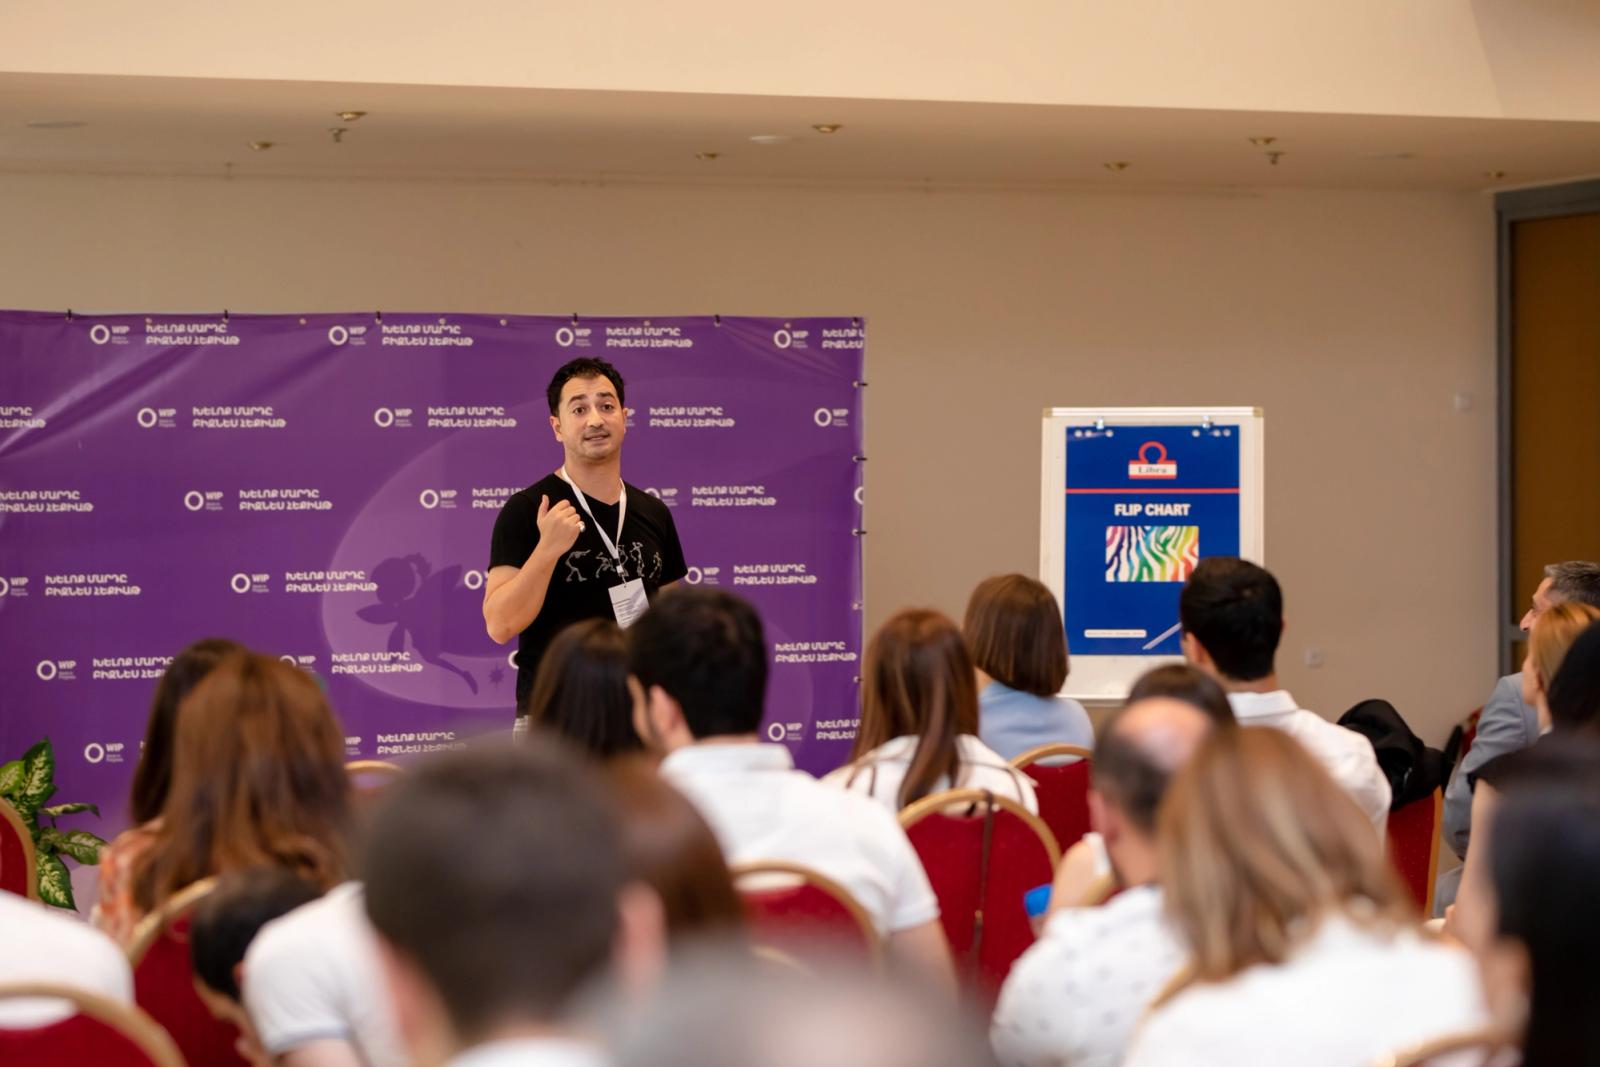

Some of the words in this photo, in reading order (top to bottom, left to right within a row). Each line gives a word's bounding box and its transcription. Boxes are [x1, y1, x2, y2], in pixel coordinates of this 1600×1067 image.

[112, 326, 129, 334] WIP
[350, 326, 366, 335] WIP
[575, 329, 591, 337] WIP
[790, 331, 808, 339] WIP
[158, 408, 176, 417] WIP
[394, 408, 413, 417] WIP
[831, 409, 848, 417] WIP
[1138, 466, 1167, 474] Libra
[205, 491, 224, 499] WIP
[440, 490, 457, 498] WIP
[661, 488, 678, 496] WIP
[1114, 503, 1142, 516] FLIP
[1145, 503, 1191, 516] CHART
[702, 567, 720, 576] WIP
[10, 577, 29, 585] WIP
[251, 573, 270, 583] WIP
[298, 655, 316, 664] WIP
[58, 660, 76, 669] WIP
[785, 723, 803, 731] WIP
[344, 736, 362, 745] WIP
[107, 743, 124, 752] WIP
